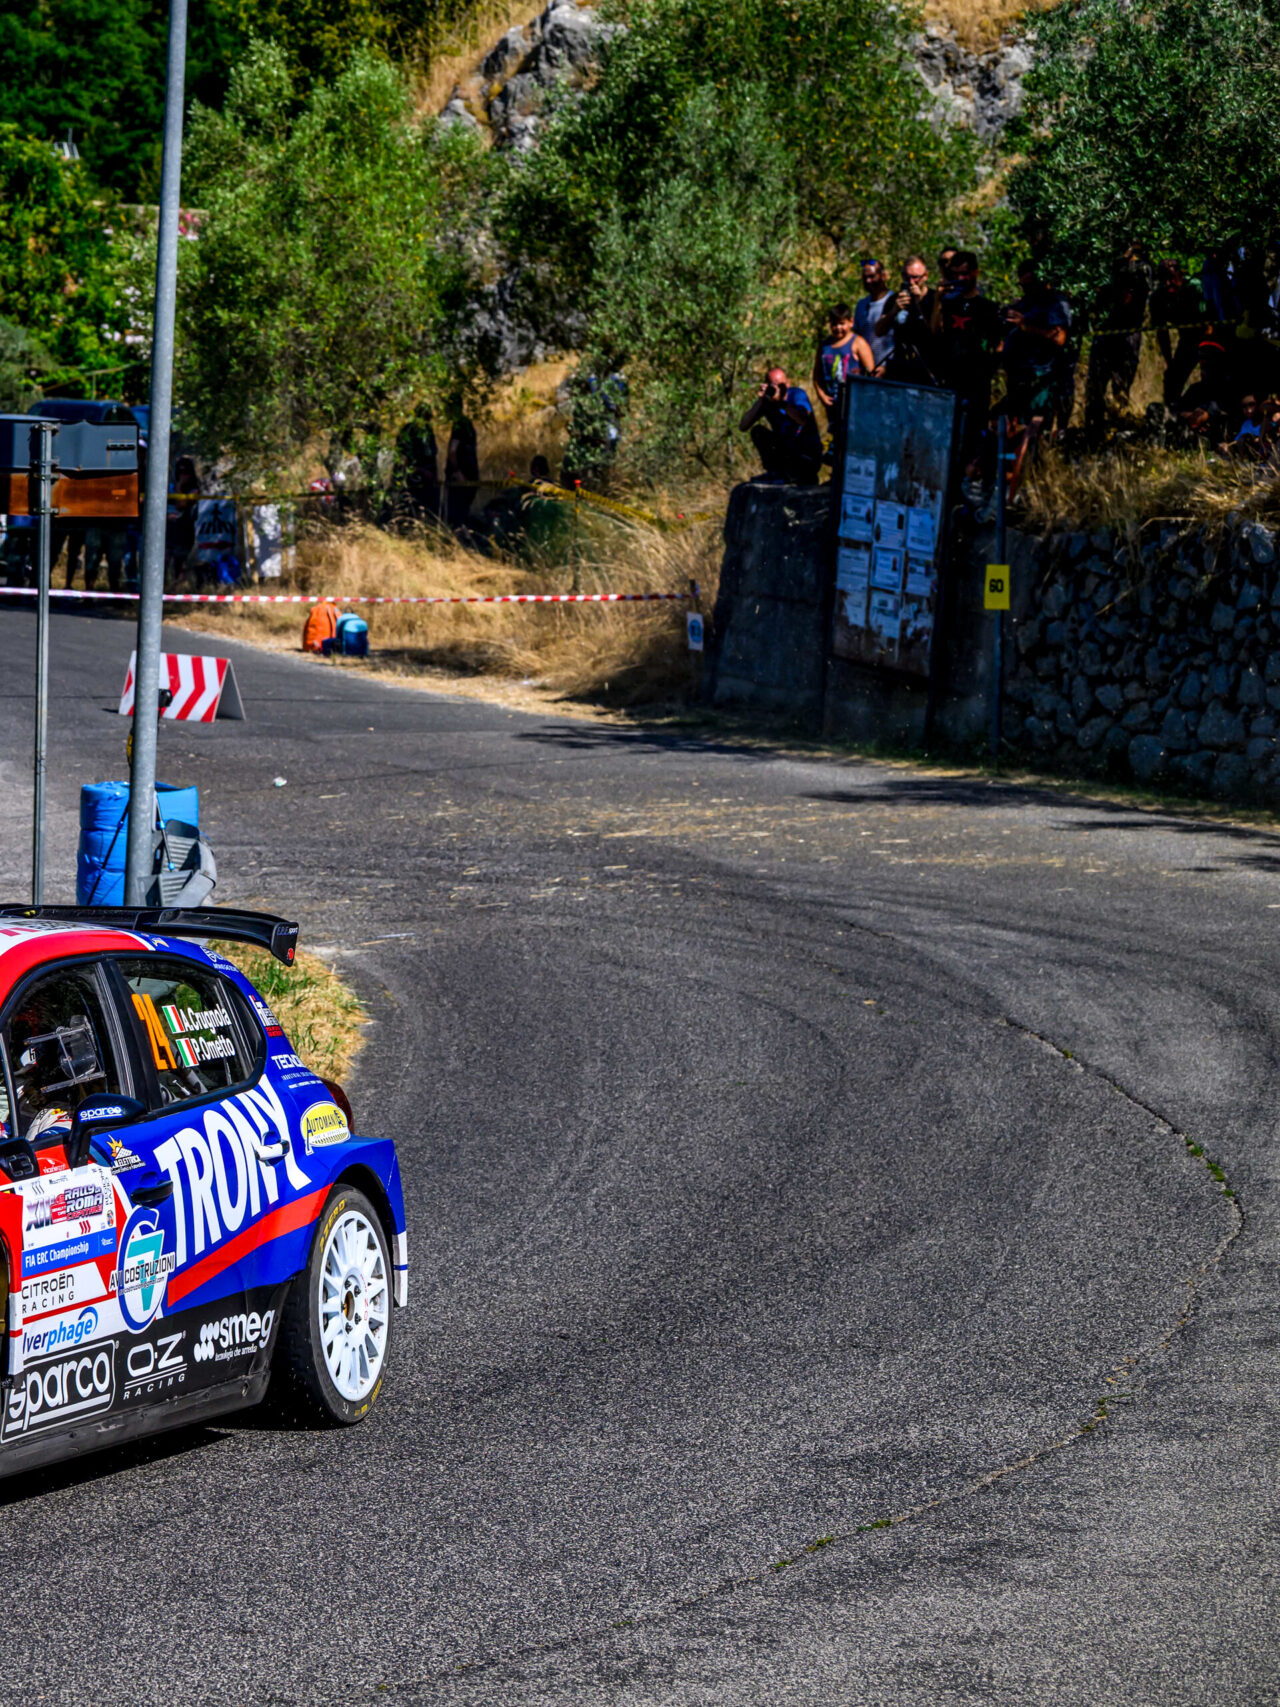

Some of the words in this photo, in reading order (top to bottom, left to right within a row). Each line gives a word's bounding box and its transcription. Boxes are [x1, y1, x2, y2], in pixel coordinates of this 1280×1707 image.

[988, 578, 1004, 593] 60
[180, 1003, 233, 1034] A.Crugnola
[190, 1034, 236, 1062] P.Ometto
[153, 1074, 312, 1268] TRONY
[64, 1184, 96, 1200] RALLY
[66, 1193, 105, 1213] ROMA
[25, 1253, 36, 1269] FIA
[36, 1251, 48, 1265] ERC
[49, 1240, 90, 1262] Championship
[124, 1254, 176, 1284] COSTRUZIONI
[21, 1291, 75, 1314] RACING
[219, 1309, 276, 1349] smeg
[8, 1350, 111, 1431] sparco
[123, 1372, 186, 1401] RACING
